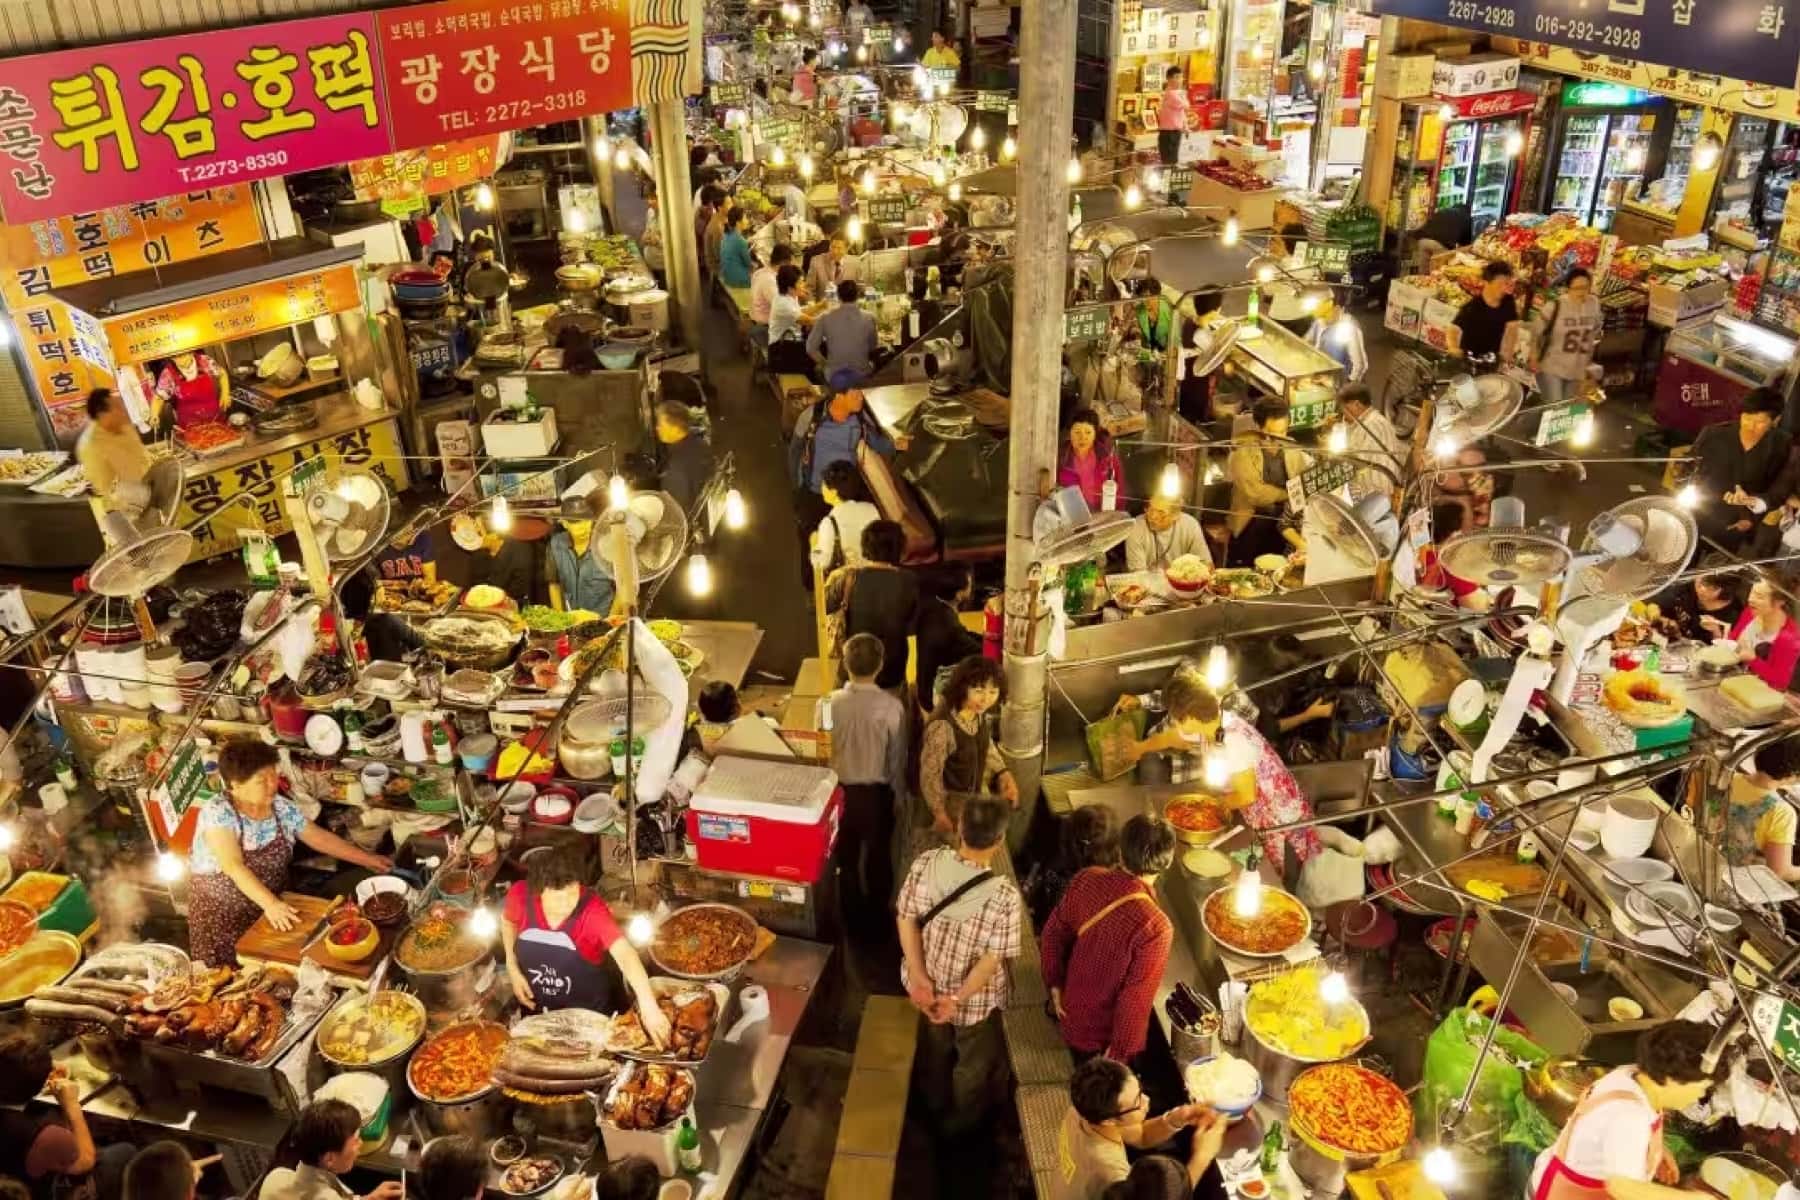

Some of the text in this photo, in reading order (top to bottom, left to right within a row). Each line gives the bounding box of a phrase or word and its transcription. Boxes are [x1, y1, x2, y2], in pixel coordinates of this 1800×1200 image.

[1535, 14, 1641, 49] 016-292-2928
[400, 26, 616, 105] 광장식당
[485, 89, 588, 123] 2272-3318
[1470, 96, 1513, 115] Coca-Cola
[178, 150, 288, 184] T.2273-8330
